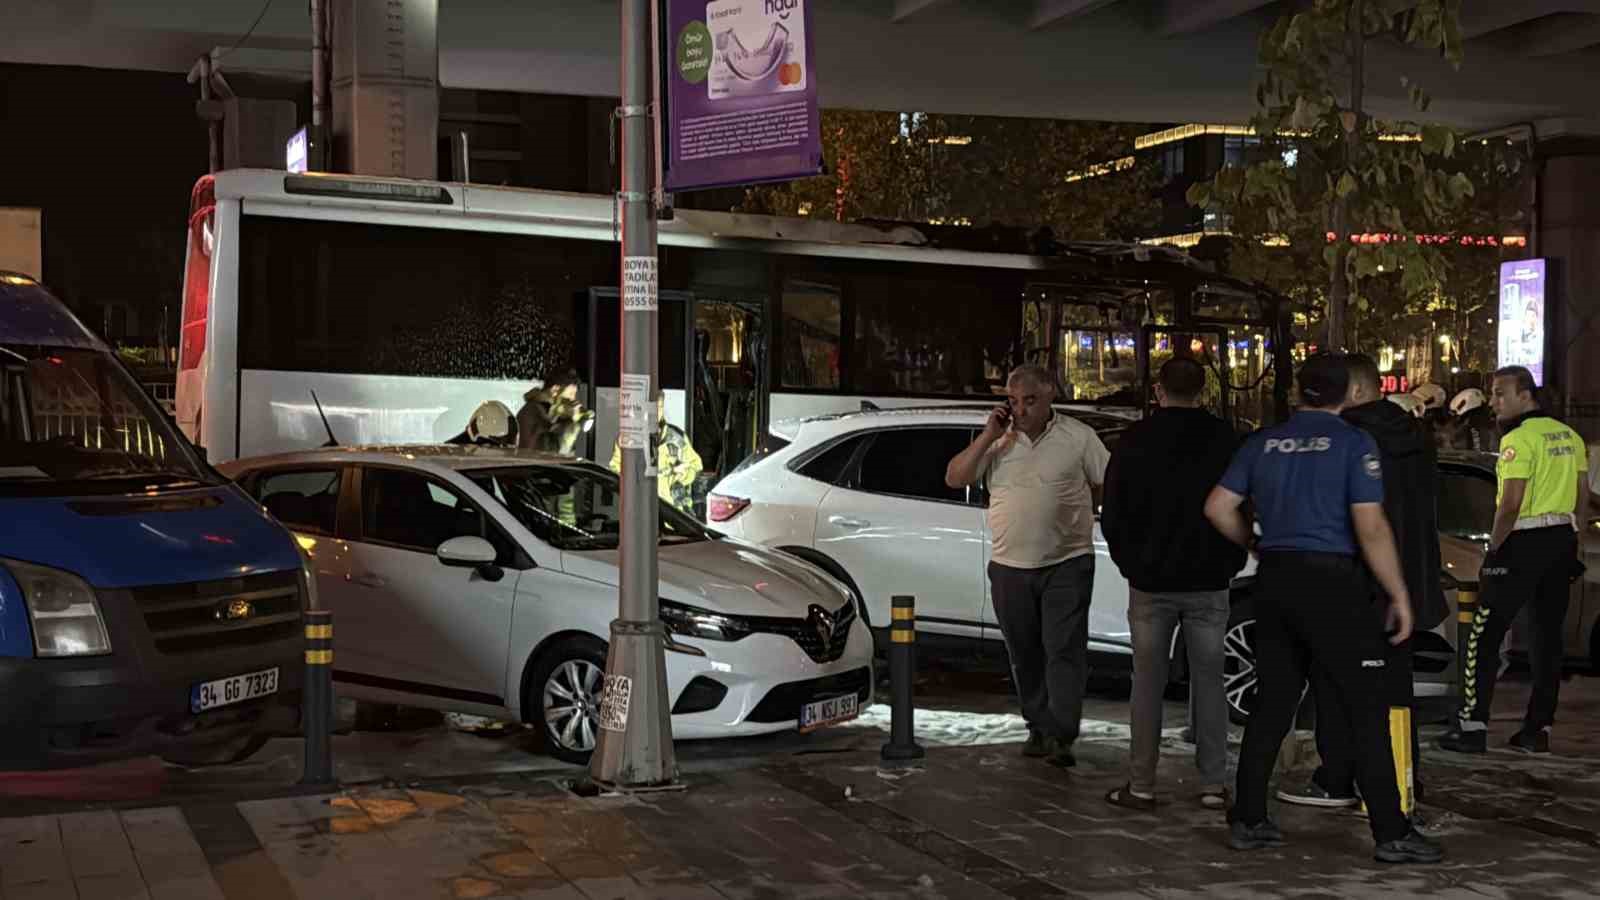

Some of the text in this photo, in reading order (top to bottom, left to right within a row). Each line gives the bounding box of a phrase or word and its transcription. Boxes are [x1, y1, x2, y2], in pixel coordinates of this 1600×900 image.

[625, 260, 649, 270] BOYA
[202, 670, 276, 706] 34 GG 7323
[808, 704, 817, 723] 34
